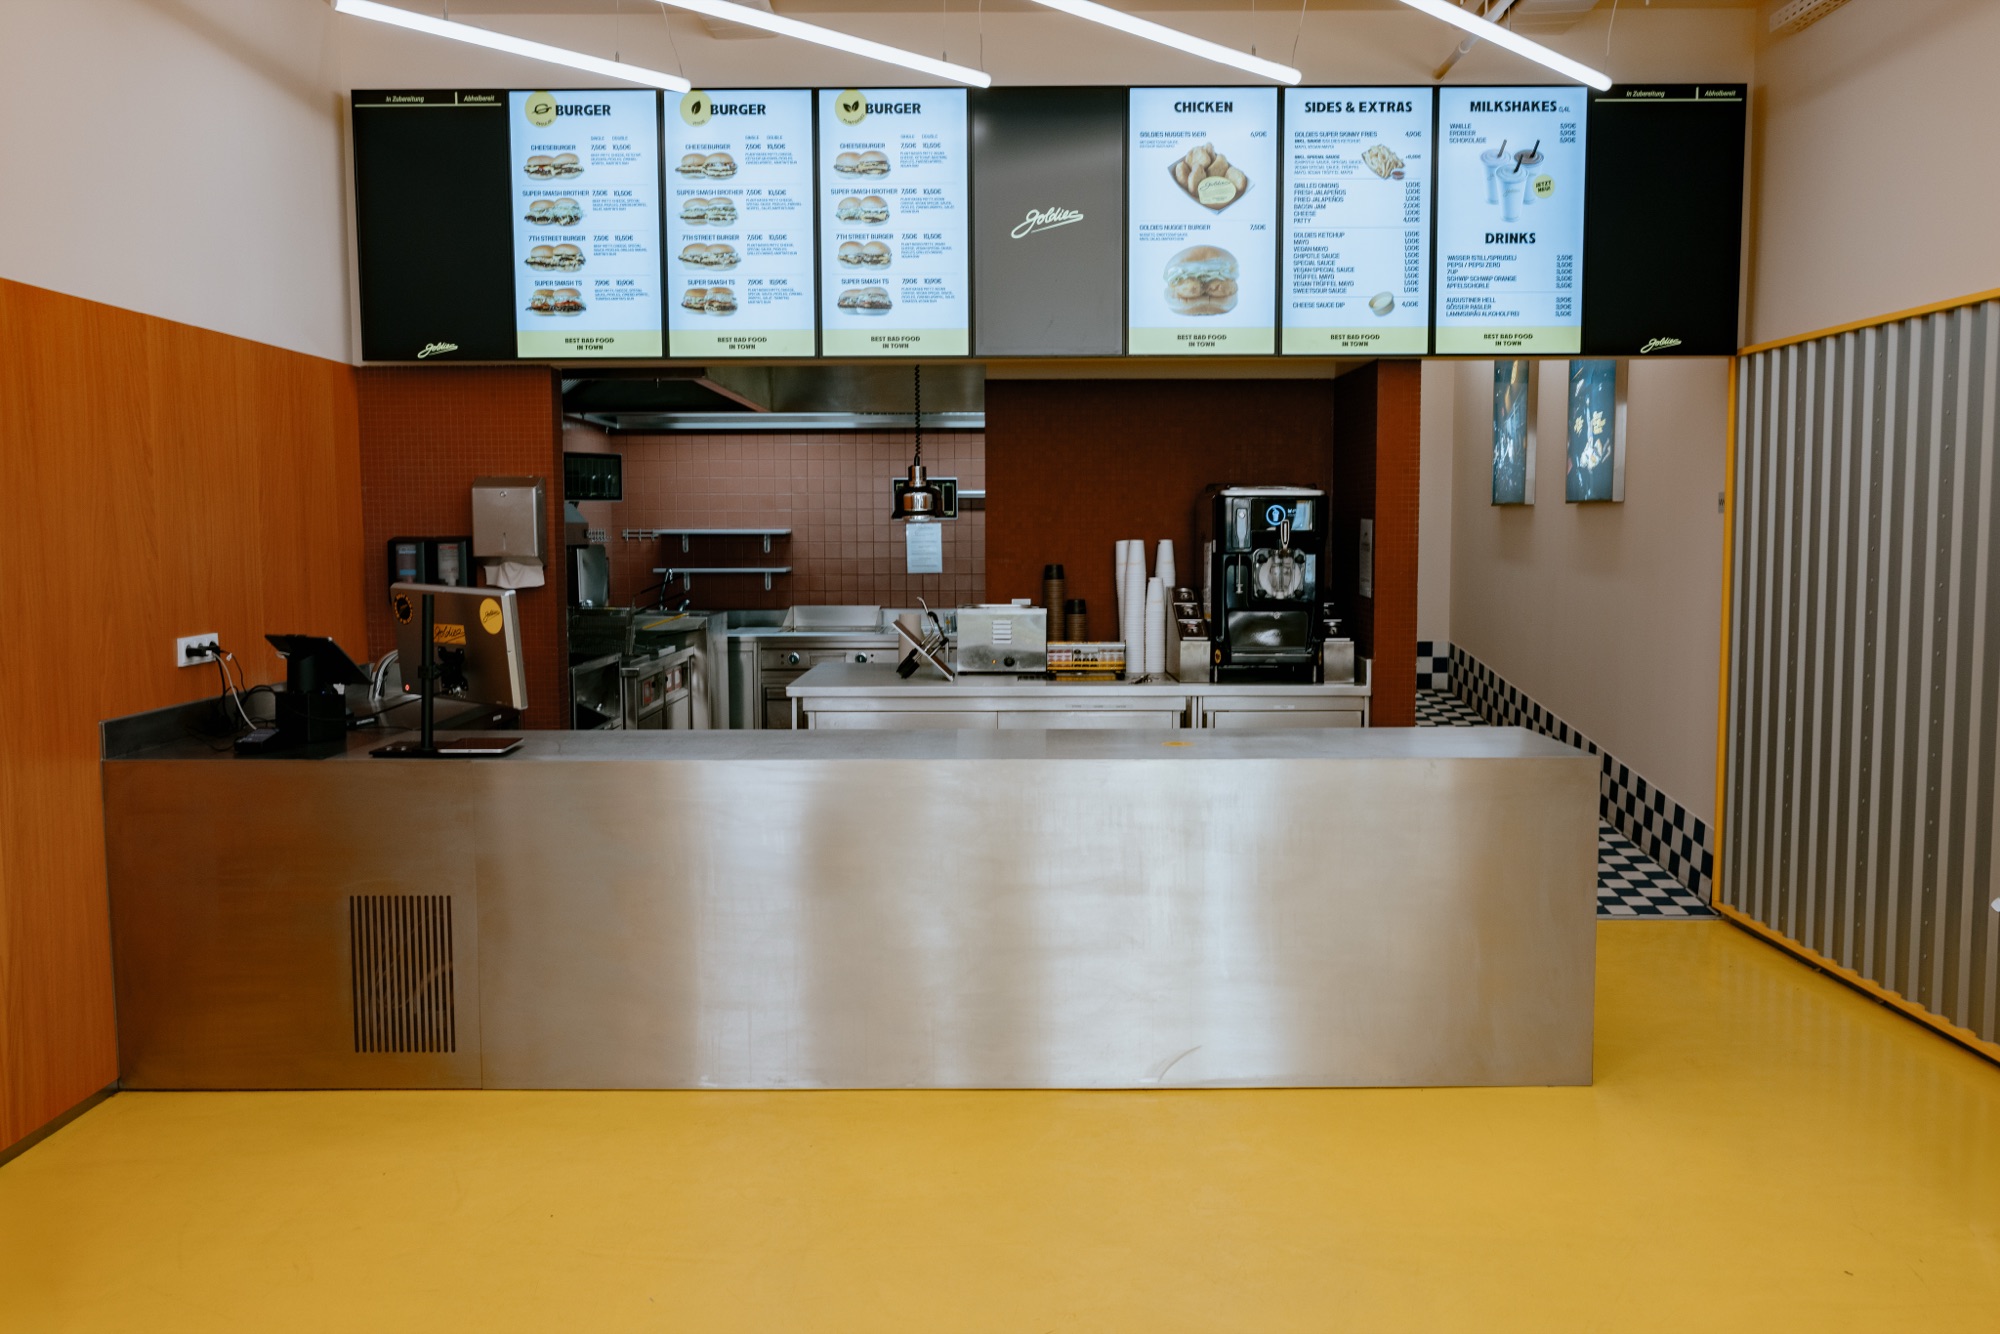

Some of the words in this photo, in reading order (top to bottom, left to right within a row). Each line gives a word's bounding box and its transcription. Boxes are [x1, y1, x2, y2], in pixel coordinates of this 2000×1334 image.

[556, 104, 611, 116] BURGER
[710, 104, 766, 115] BURGER
[865, 103, 921, 114] BURGER
[1174, 102, 1233, 112] CHICKEN
[1305, 102, 1342, 112] SIDES
[1346, 102, 1355, 112] &
[1359, 102, 1412, 112] EXTRAS
[1470, 101, 1557, 112] MILKSHAKES
[1485, 233, 1536, 244] DRINKS
